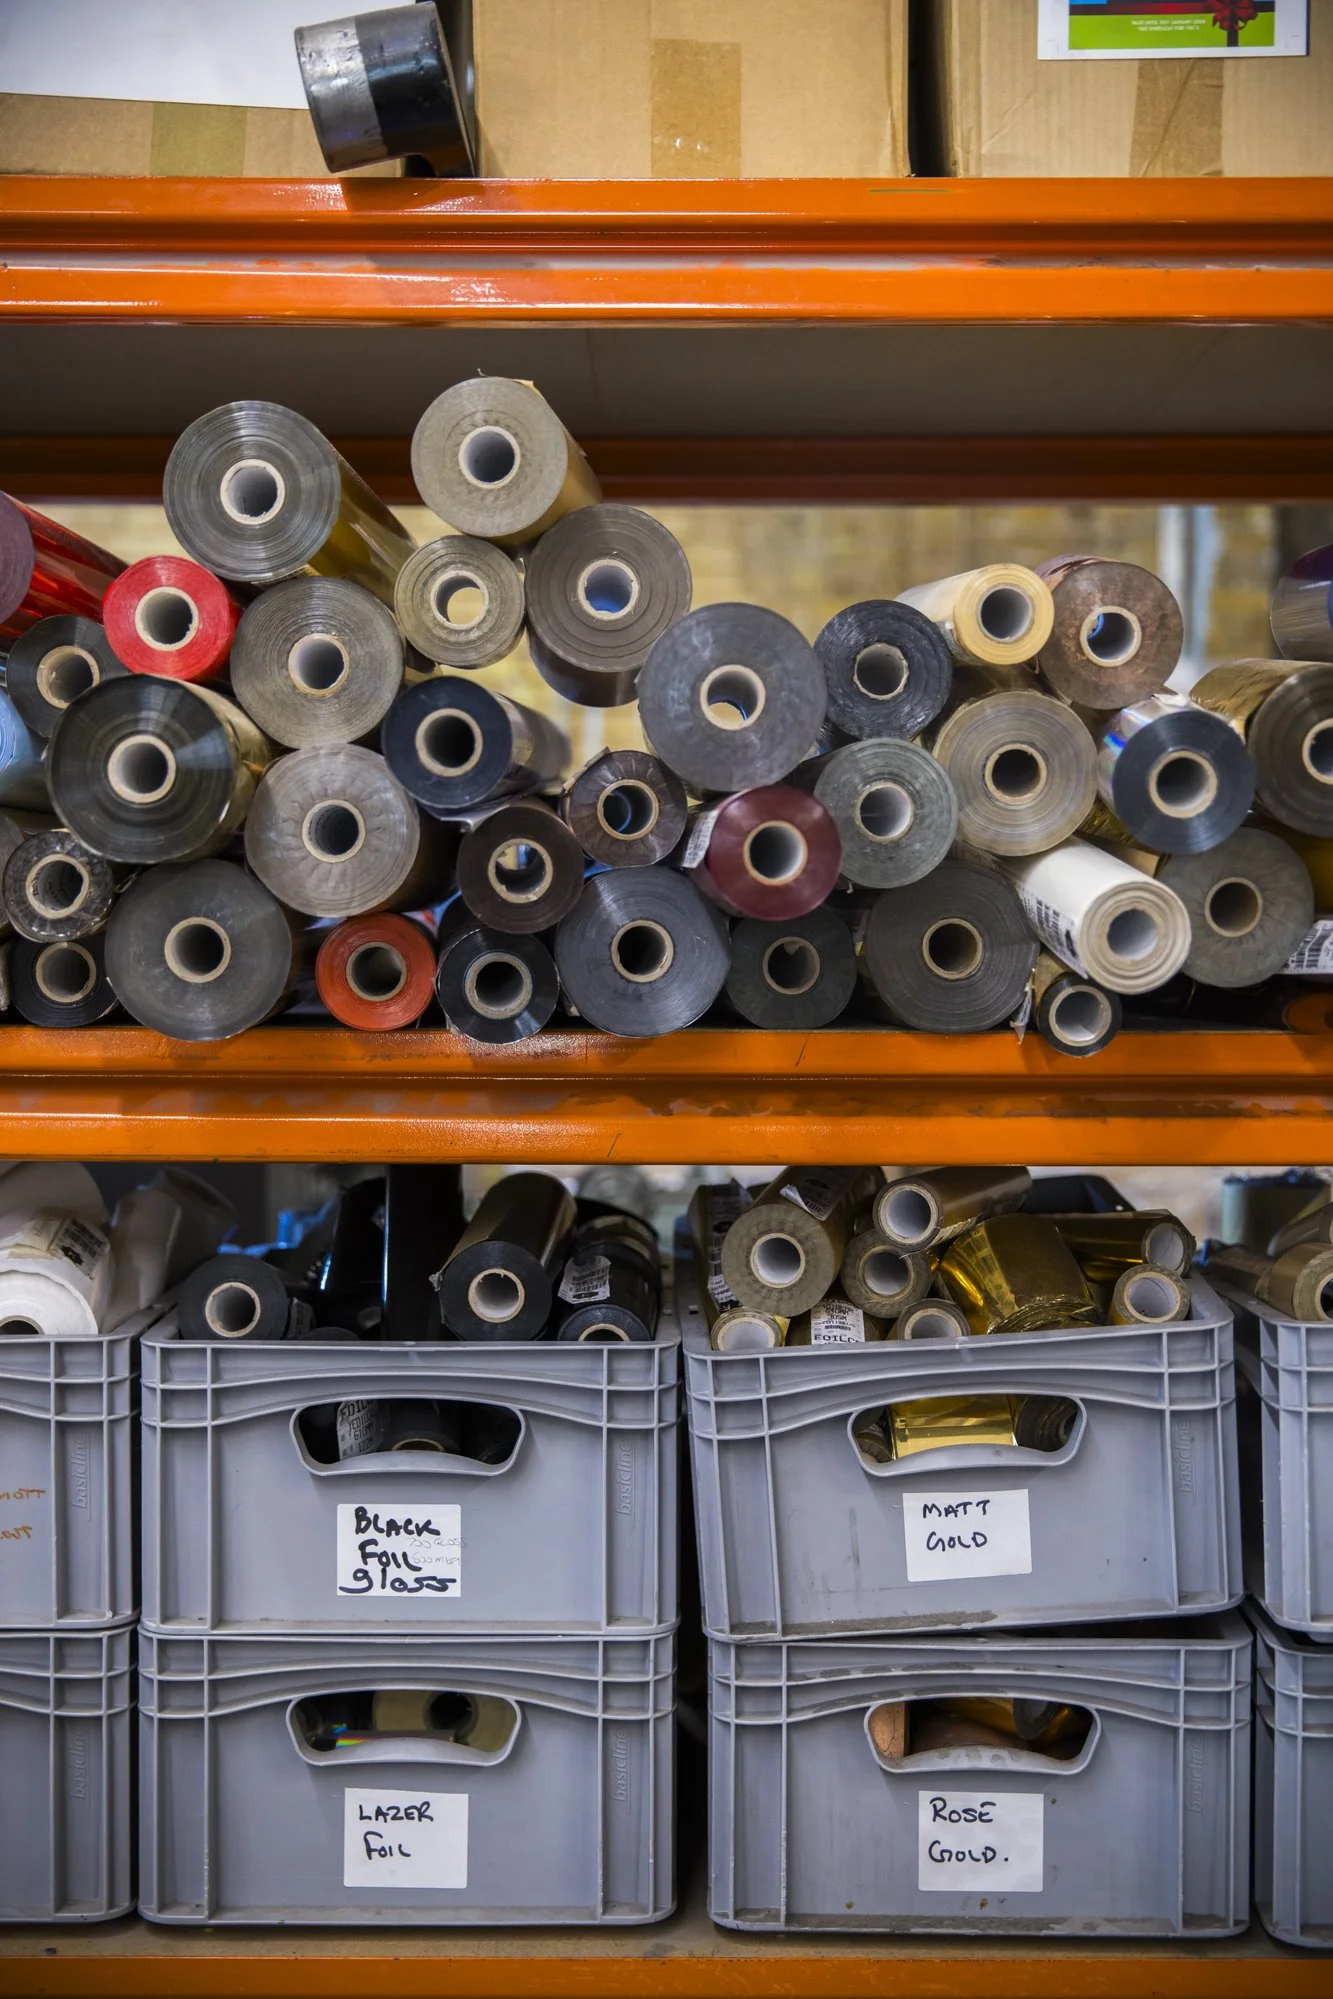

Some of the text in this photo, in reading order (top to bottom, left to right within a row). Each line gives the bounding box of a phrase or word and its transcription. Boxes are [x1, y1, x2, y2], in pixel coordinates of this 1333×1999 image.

[355, 1506, 441, 1538] BLACK
[923, 1499, 991, 1519] MATT
[926, 1531, 988, 1552] GOLD
[358, 1538, 423, 1572] FOIL
[359, 1801, 434, 1823] LAZER
[929, 1797, 997, 1823] ROSE
[363, 1831, 411, 1861] FOIL
